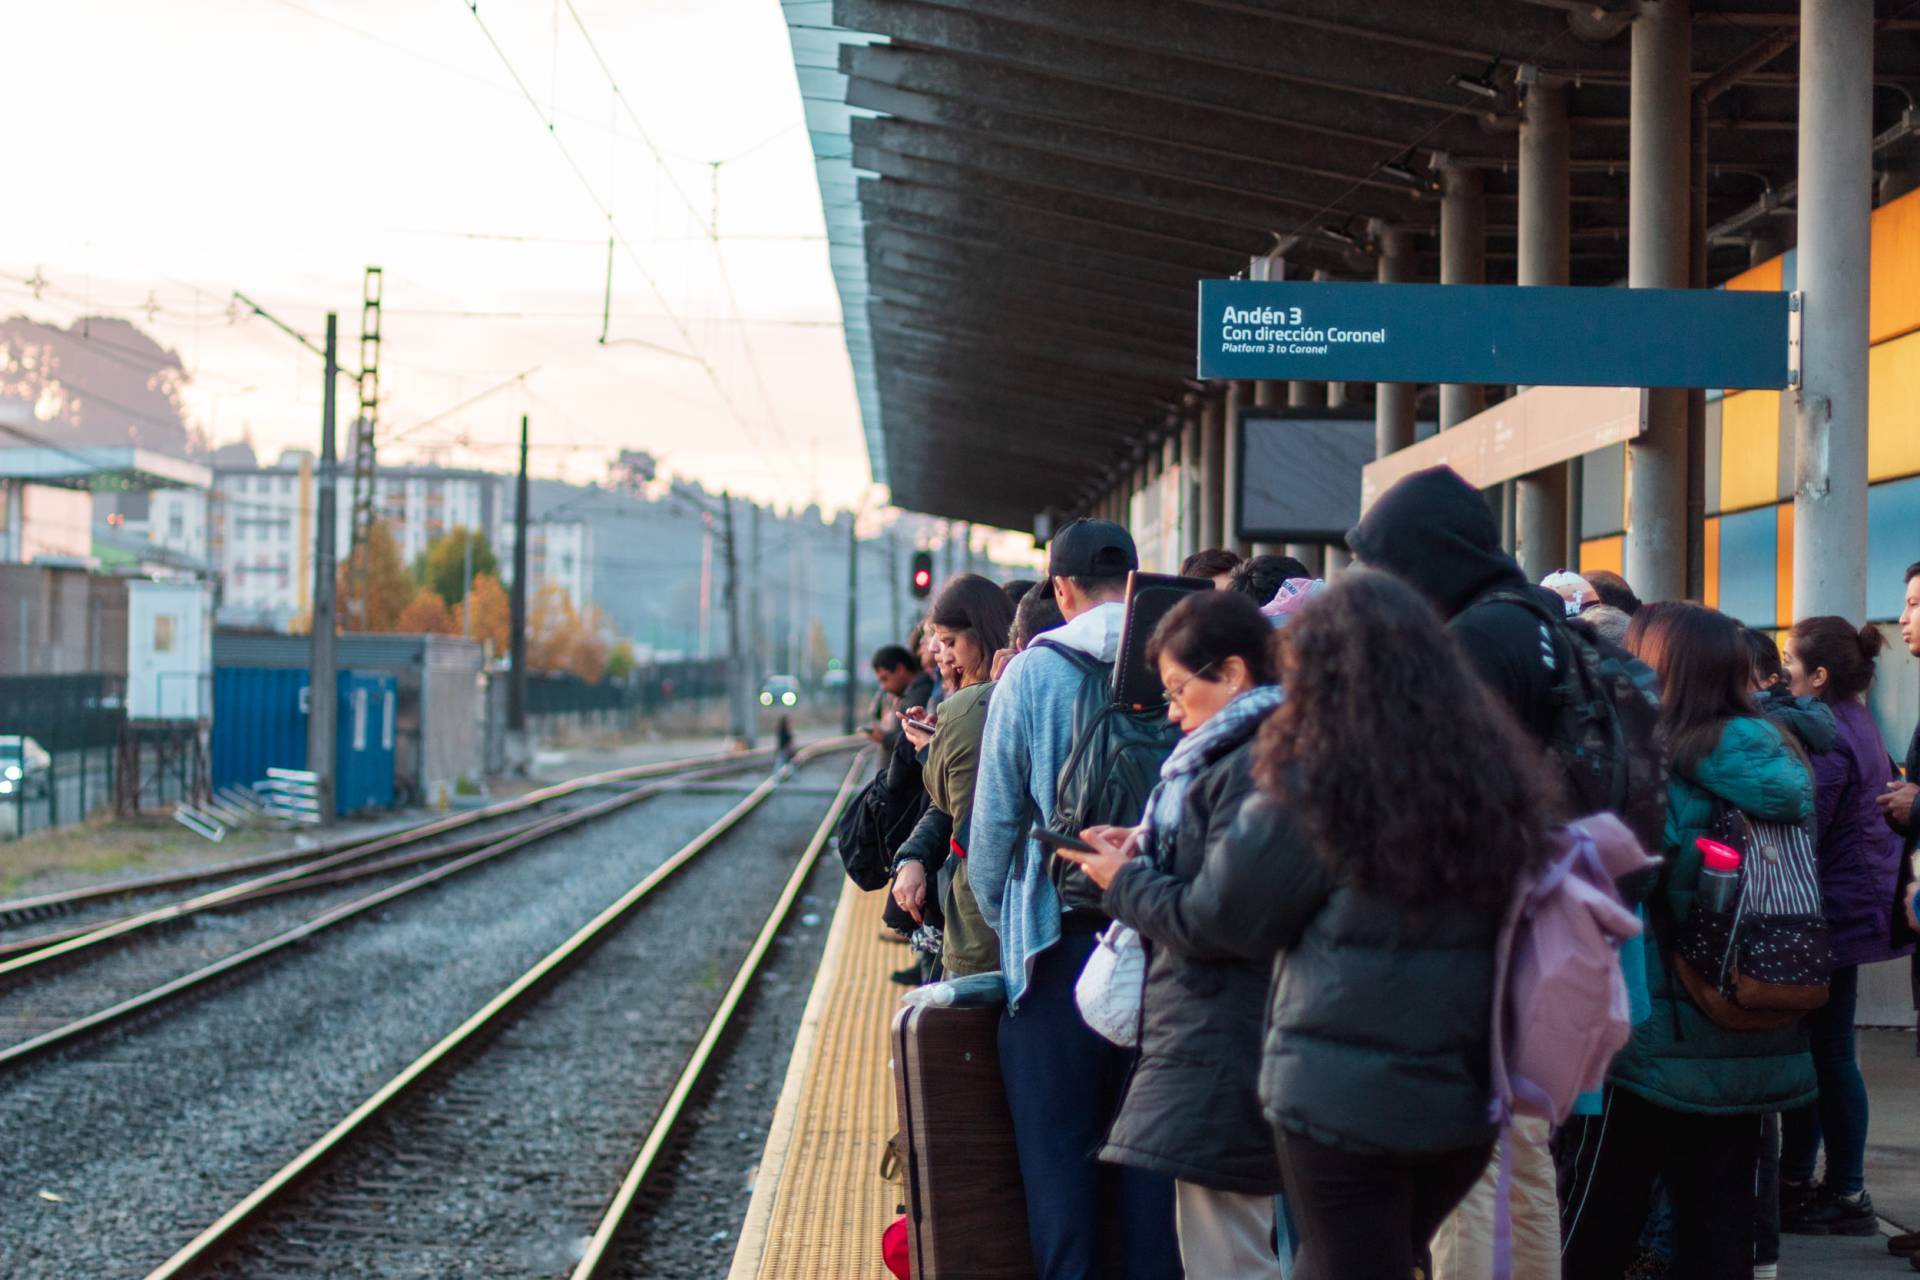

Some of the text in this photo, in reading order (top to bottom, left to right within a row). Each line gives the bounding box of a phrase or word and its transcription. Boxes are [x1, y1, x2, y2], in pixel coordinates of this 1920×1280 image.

[1222, 305, 1302, 325] Andén 3
[1222, 325, 1386, 343] Con dirección Coronel
[1221, 342, 1328, 355] Platform 3 to Coronel
